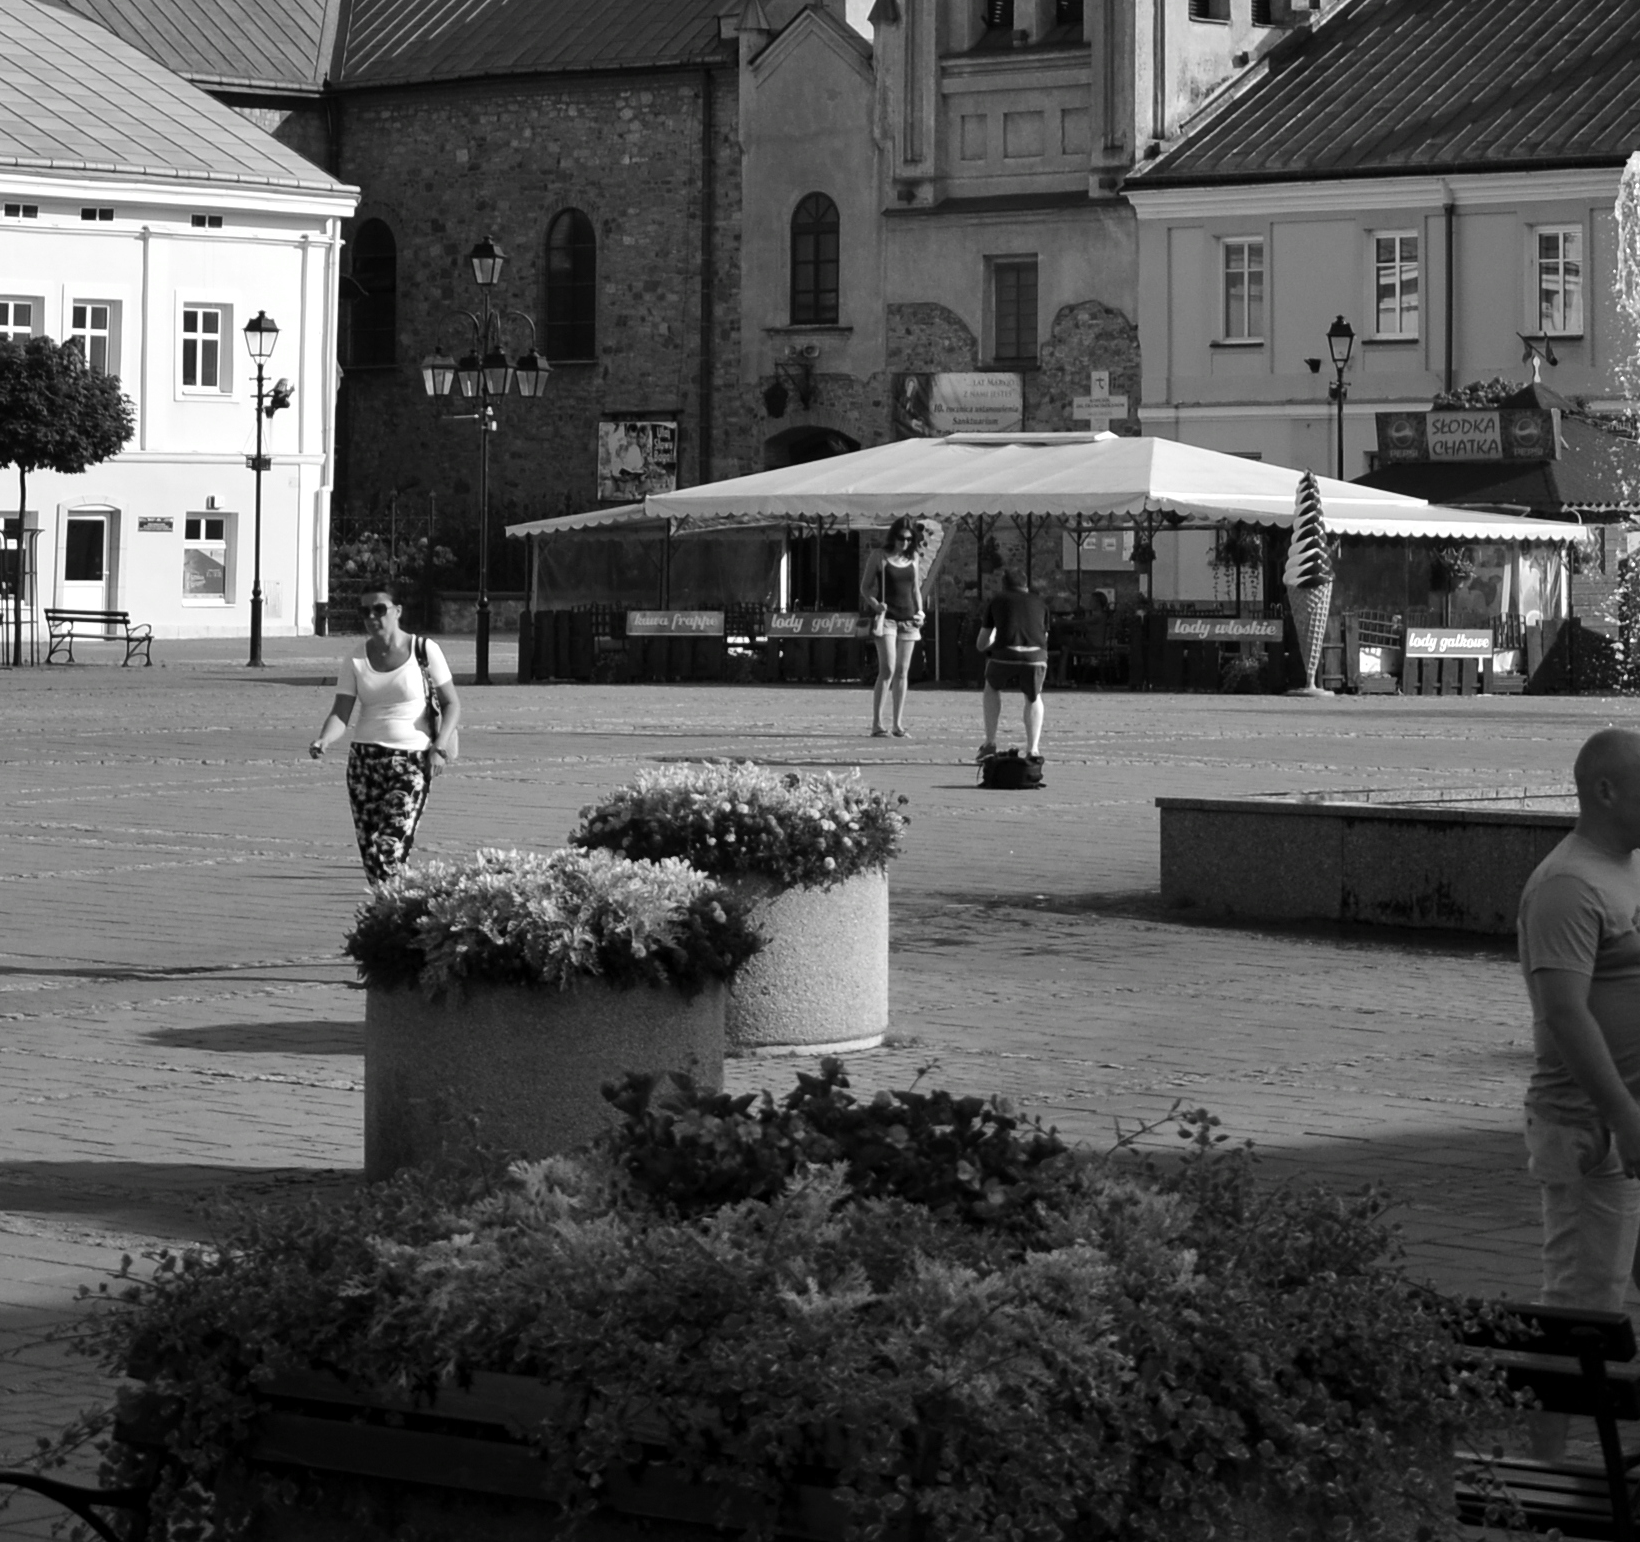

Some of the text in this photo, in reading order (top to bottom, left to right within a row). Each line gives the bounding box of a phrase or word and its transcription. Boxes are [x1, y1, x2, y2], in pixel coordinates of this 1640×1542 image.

[1431, 417, 1496, 435] SŁODKA
[1432, 439, 1500, 456] CHATKA
[1514, 447, 1543, 456] PEPSI
[634, 613, 669, 626] kawa
[771, 613, 855, 633] lody gofry
[1174, 619, 1211, 638] lody
[1409, 632, 1438, 652] lody
